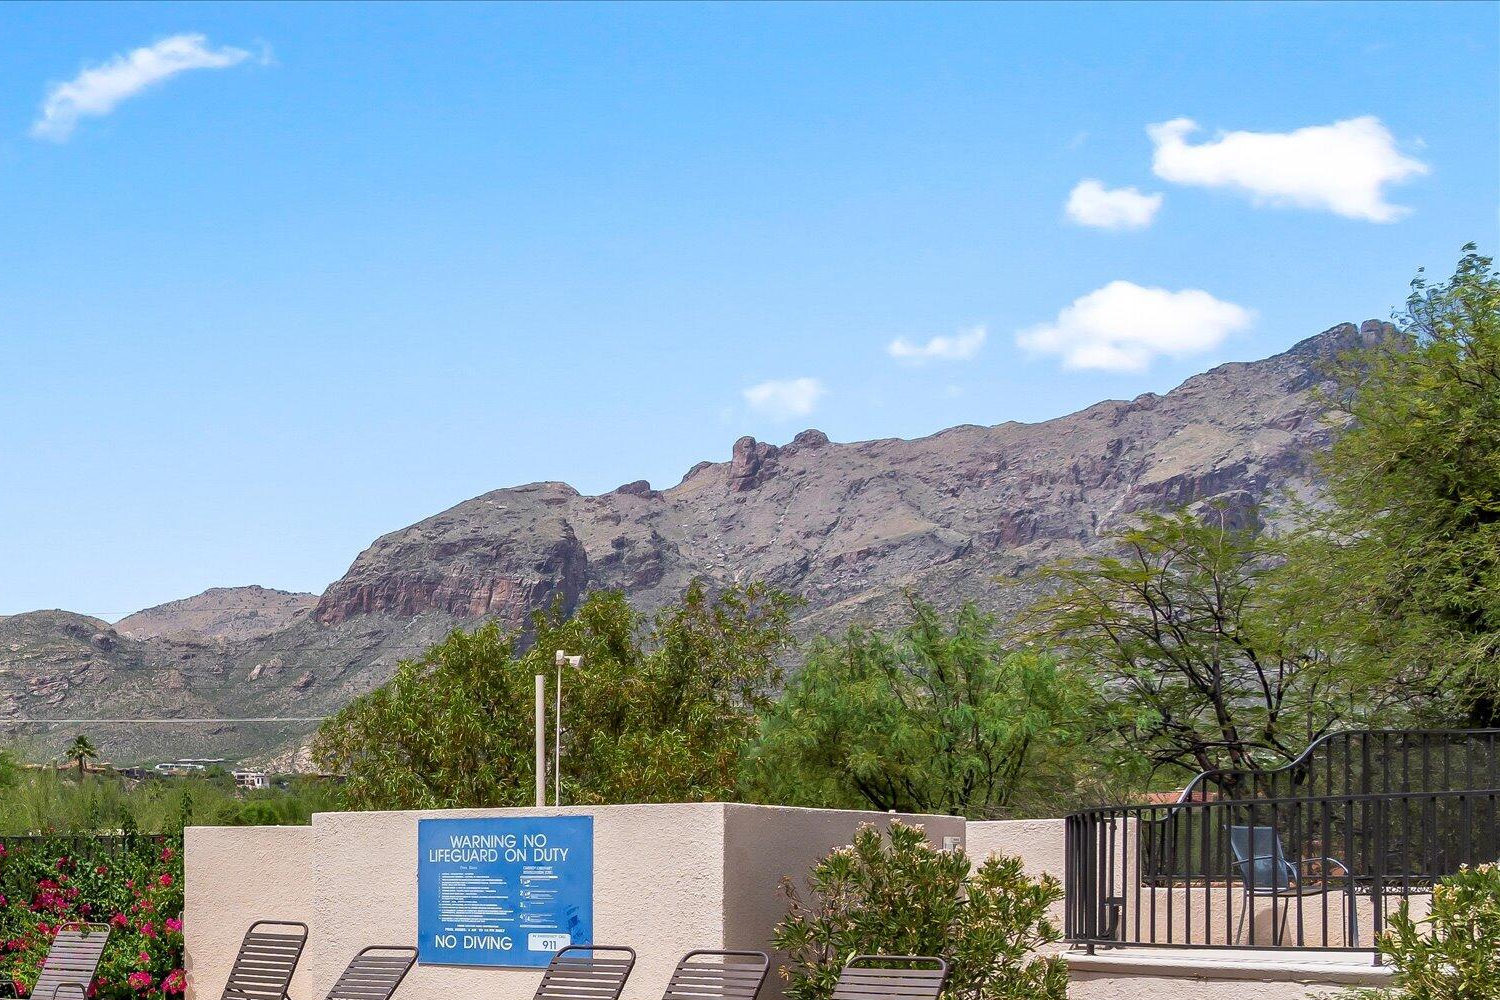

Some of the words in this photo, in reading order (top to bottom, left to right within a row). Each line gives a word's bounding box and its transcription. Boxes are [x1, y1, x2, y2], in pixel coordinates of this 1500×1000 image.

[449, 834, 517, 849] WARNING
[523, 833, 547, 848] NO
[429, 848, 498, 863] LIFEGUARD
[504, 848, 528, 863] ON
[533, 847, 569, 862] DUTY
[435, 934, 457, 949] NO
[463, 935, 513, 951] DIVING
[542, 940, 557, 950] 911
